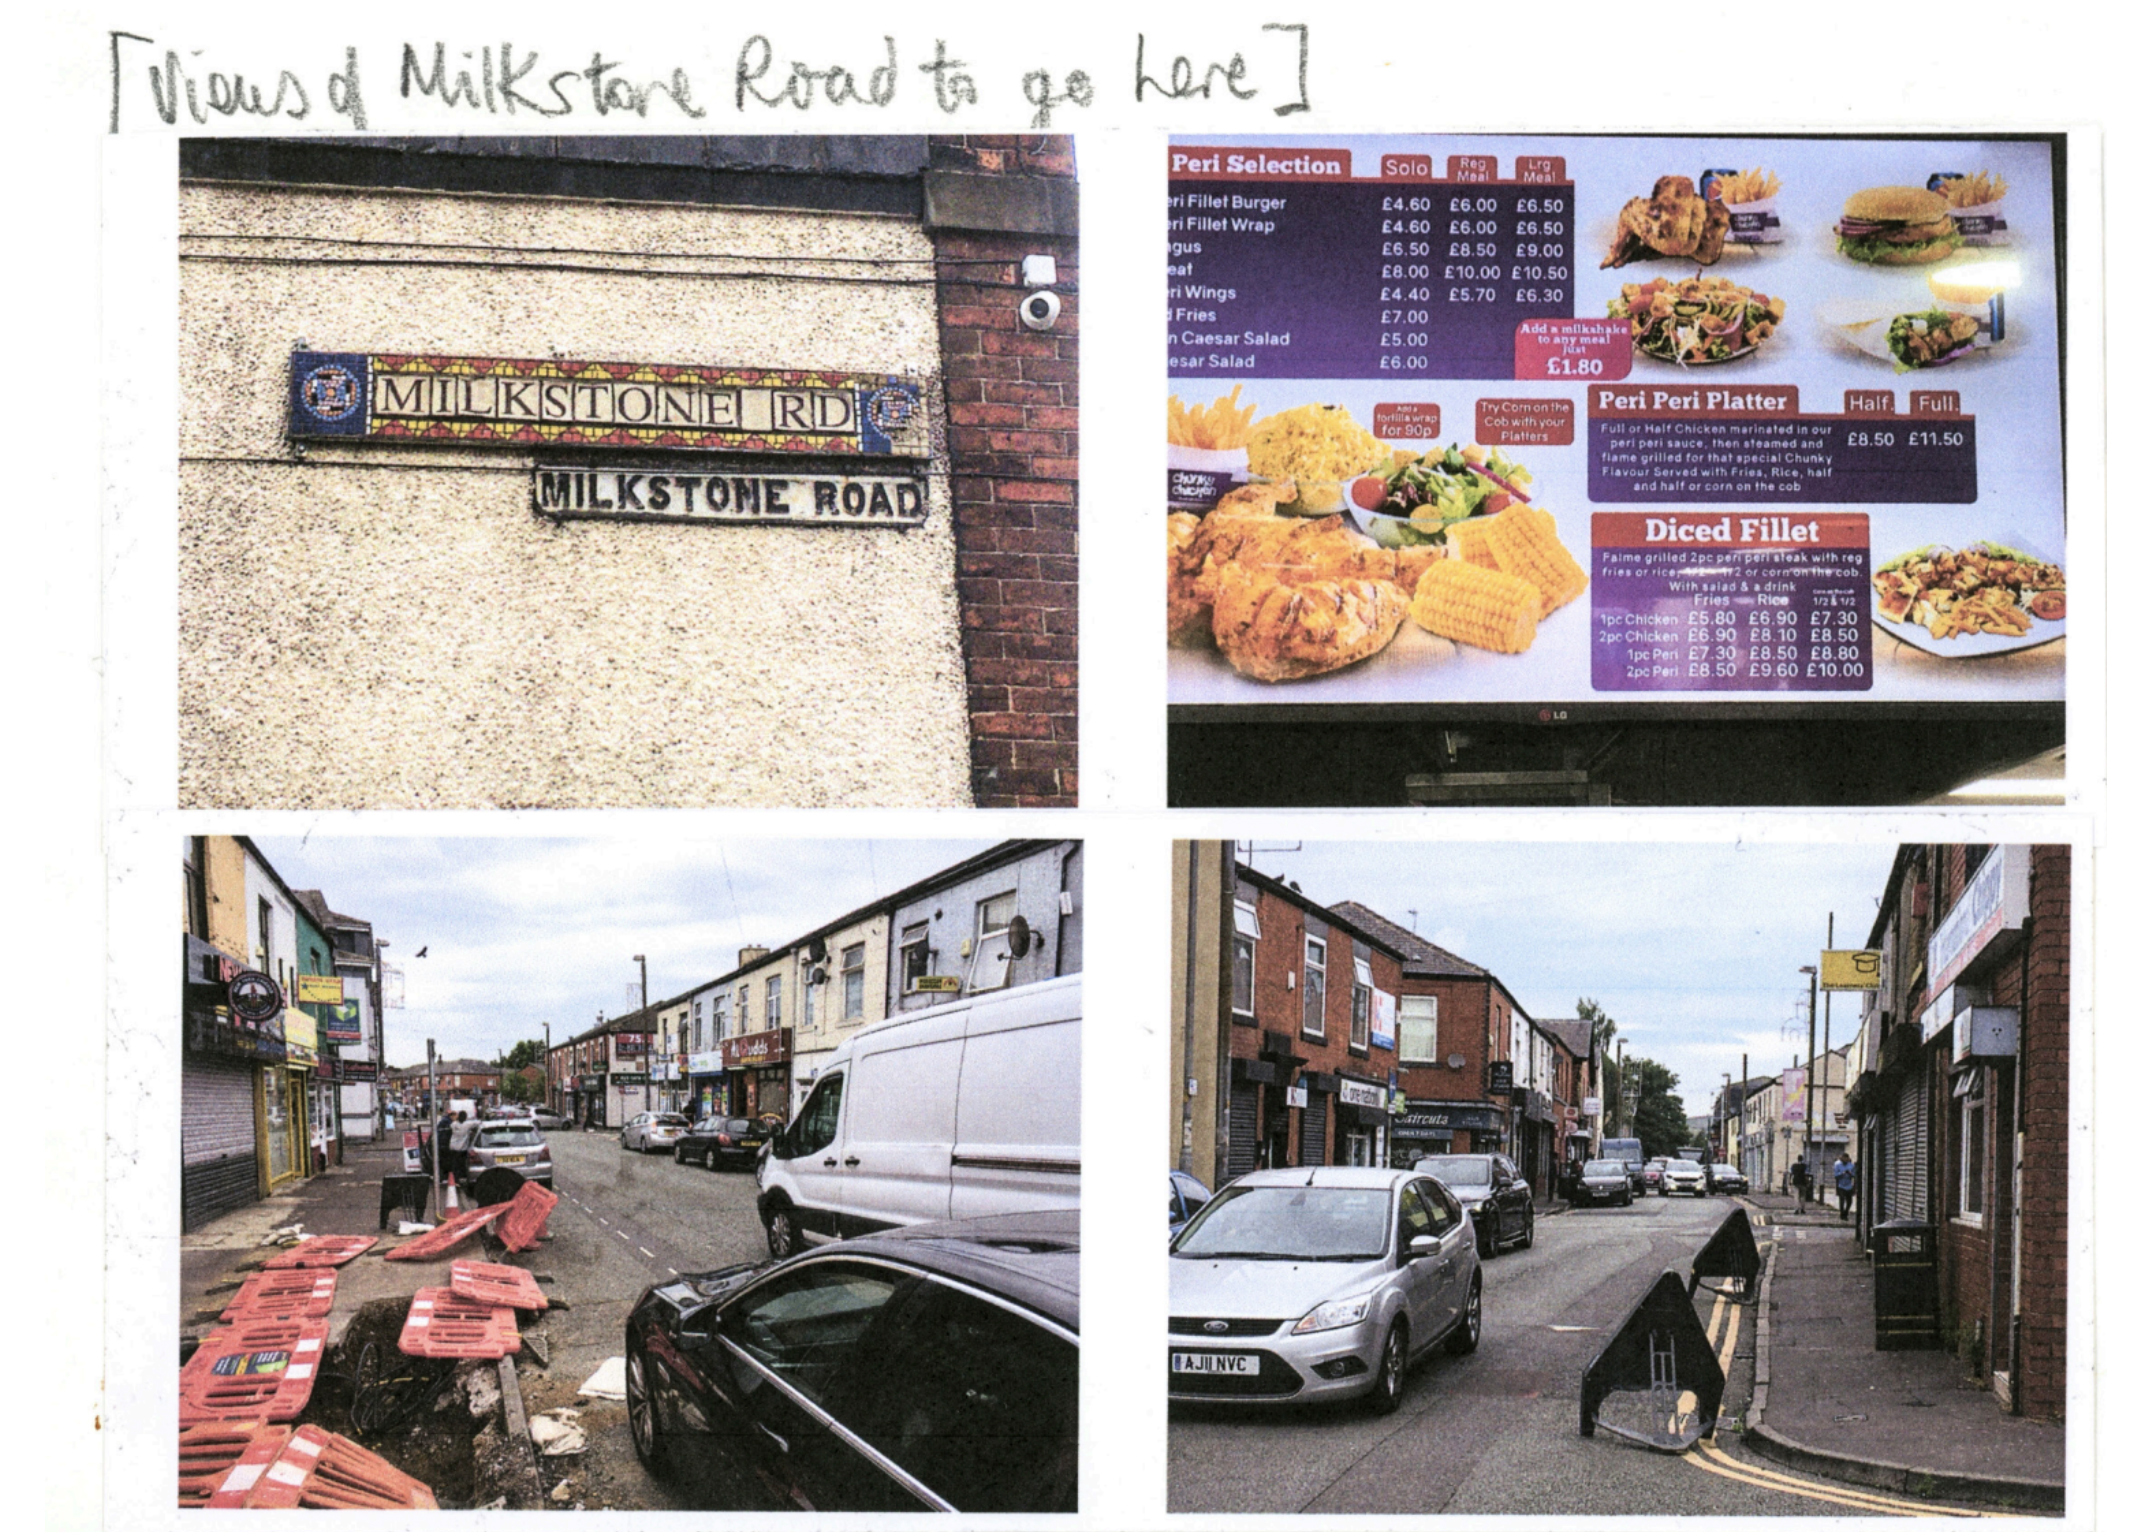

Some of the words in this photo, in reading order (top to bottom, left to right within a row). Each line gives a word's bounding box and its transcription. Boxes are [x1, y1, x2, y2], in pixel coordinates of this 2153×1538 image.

[735, 34, 898, 112] Road
[918, 39, 979, 112] to
[1022, 69, 1094, 128] go
[1172, 154, 1219, 172] Peri
[1227, 154, 1340, 174] Selection
[1386, 160, 1428, 176] Solo
[1458, 157, 1485, 171] Reg
[1529, 159, 1551, 172] Lrg
[1458, 170, 1488, 181] Meal
[1524, 172, 1554, 182] Meal
[1188, 194, 1228, 208] Fillet
[1232, 195, 1286, 212] Burger
[1382, 197, 1430, 211] £4.60
[1450, 198, 1496, 212] £6.00
[1517, 198, 1563, 212] £6.50
[1187, 216, 1226, 230] Fillet
[1231, 218, 1274, 234] Wrap
[1382, 219, 1430, 233] £4.60
[1450, 220, 1496, 234] £6.00
[1516, 221, 1562, 235] £6.50
[1382, 242, 1428, 255] £6.50
[1449, 242, 1496, 256] £8.50
[1516, 243, 1562, 257] £9.00
[1382, 264, 1428, 278] £8.00
[1444, 265, 1500, 279] £10.00
[1512, 266, 1567, 280] £10.50
[1185, 285, 1235, 302] Wings
[1380, 287, 1429, 300] £4.40
[1449, 287, 1495, 301] £5.70
[1516, 288, 1562, 302] £6.30
[1176, 308, 1216, 321] Fries
[1381, 310, 1428, 323] £7.00
[1520, 324, 1547, 334] Add
[1562, 324, 1628, 334] milkshake
[1182, 331, 1239, 344] Caesar
[1244, 331, 1289, 345] Salad
[1380, 332, 1427, 346] £5.00
[1553, 336, 1576, 346] any
[1580, 334, 1609, 343] meal
[1208, 354, 1254, 367] Salad
[1380, 355, 1427, 368] £6.00
[1546, 357, 1603, 375] £1.80
[382, 378, 734, 426] MILKSTONE
[779, 394, 850, 428] RD
[1481, 401, 1499, 414] Try
[1502, 402, 1531, 412] Corn
[1533, 404, 1548, 412] on
[1551, 402, 1569, 412] the
[1600, 390, 1646, 408] Peri
[1653, 390, 1699, 409] Peri
[1707, 391, 1786, 410] Platter
[1376, 413, 1410, 422] tortilla
[1412, 415, 1437, 424] wrap
[1484, 416, 1508, 426] Cob
[1511, 416, 1536, 426] with
[1540, 418, 1564, 428] your
[1382, 424, 1402, 436] for
[1405, 424, 1432, 438] 90p
[1501, 430, 1548, 442] Platters
[1601, 423, 1624, 433] Full
[1645, 424, 1670, 433] Half
[1675, 424, 1725, 433] Chicken
[1730, 424, 1792, 434] marinated
[1610, 438, 1634, 449] peri
[1639, 440, 1662, 449] peri
[1712, 439, 1738, 447] then
[1744, 439, 1796, 448] steamed
[1848, 432, 1894, 445] £8.50
[1909, 432, 1962, 445] £11.50
[1602, 452, 1636, 462] flame
[1641, 452, 1681, 464] grilled
[1686, 453, 1702, 462] for
[1708, 453, 1732, 462] that
[1737, 453, 1780, 464] special
[1785, 453, 1831, 464] Chunky
[1602, 466, 1648, 476] Flavour
[1654, 466, 1696, 476] Served
[1701, 467, 1726, 476] with
[1808, 468, 1831, 476] half
[1634, 481, 1656, 490] and
[1660, 481, 1684, 490] half
[1755, 482, 1774, 490] the
[1779, 481, 1800, 490] cob
[541, 473, 790, 514] MILKSTONE
[814, 481, 922, 517] ROAD
[1646, 518, 1731, 541] Diced
[1740, 517, 1818, 541] Fillet
[1645, 552, 1686, 565] grilled
[1690, 552, 1713, 564] 2pc
[1717, 552, 1741, 564] peri
[1745, 553, 1769, 564] peri
[1774, 552, 1808, 562] steak
[1812, 552, 1838, 562] with
[1842, 554, 1863, 565] reg
[1602, 567, 1631, 576] fries
[1811, 567, 1832, 576] the
[1669, 581, 1698, 591] With
[1702, 581, 1736, 591] salad
[1765, 581, 1797, 592] drink
[1694, 593, 1730, 605] Fries
[1758, 593, 1789, 605] Rice
[1601, 614, 1623, 627] 1pc
[1625, 614, 1678, 625] Chicken
[1688, 611, 1736, 625] £5.80
[1749, 610, 1797, 624] £6.90
[1810, 611, 1857, 624] £7.30
[1600, 631, 1622, 644] 2pc
[1625, 631, 1678, 642] Chicken
[1688, 628, 1736, 642] £6.90
[1750, 628, 1796, 642] £8.10
[1811, 628, 1858, 642] £8.50
[1627, 649, 1650, 662] 1pc
[1652, 648, 1678, 659] Peri
[1688, 646, 1736, 660] £7.30
[1750, 646, 1797, 660] £8.50
[1811, 646, 1858, 659] £8.80
[1627, 665, 1650, 679] 2pc
[1652, 666, 1678, 677] Peri
[1688, 663, 1736, 677] £8.50
[1750, 663, 1798, 677] £9.60
[1806, 663, 1864, 677] £10.00
[1554, 711, 1567, 719] LG
[1217, 1356, 1246, 1371] NVC
